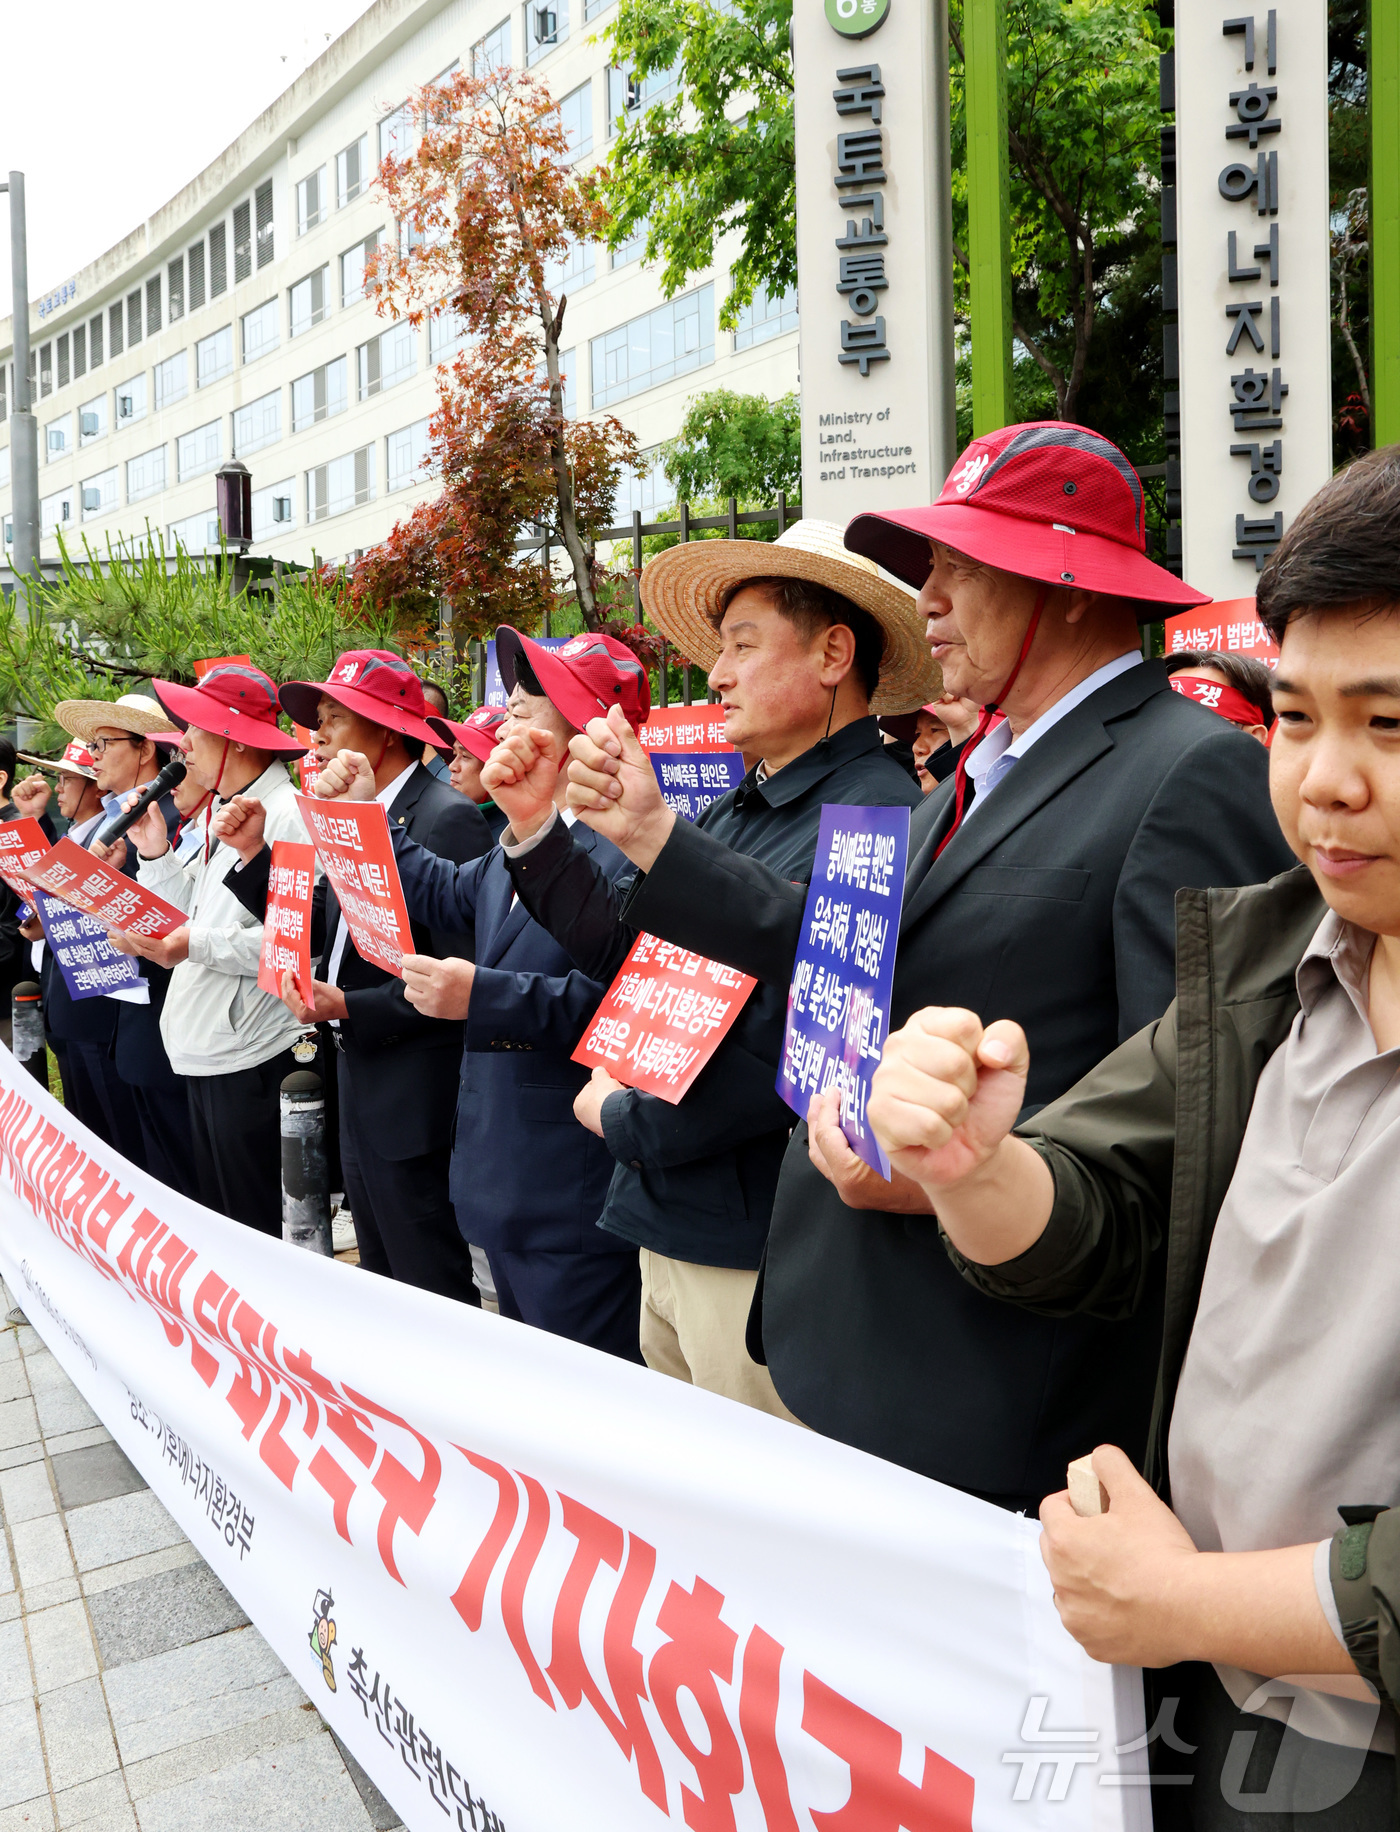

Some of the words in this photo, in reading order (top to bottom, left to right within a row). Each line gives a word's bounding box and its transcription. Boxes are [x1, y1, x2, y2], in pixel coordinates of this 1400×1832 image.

[832, 63, 891, 376] 국토교통부
[1218, 9, 1289, 572] 기후에너지환경부
[819, 412, 873, 426] Ministry
[876, 407, 890, 421] of
[819, 429, 856, 444] Land,
[819, 446, 912, 463] Infrastructure
[820, 466, 846, 481] and
[850, 462, 916, 479] Transport
[1171, 624, 1223, 651] 축산농가
[1192, 683, 1223, 708] 쟁
[640, 726, 674, 747] 축산농가
[676, 723, 705, 745] 범법자
[700, 763, 731, 788] 원인은
[310, 811, 333, 844] 원인
[328, 817, 363, 852] 모르면
[869, 833, 895, 897] 원인은
[295, 870, 310, 900] 취급
[809, 895, 852, 963] 유속저하,
[850, 908, 889, 979] 기온상승!
[611, 972, 731, 1038] 기후에너지환경부
[808, 966, 853, 1040] 축산농가
[586, 1016, 631, 1061] 장관은
[626, 1031, 700, 1085] 사퇴하라!
[783, 1027, 826, 1097] 근본대책
